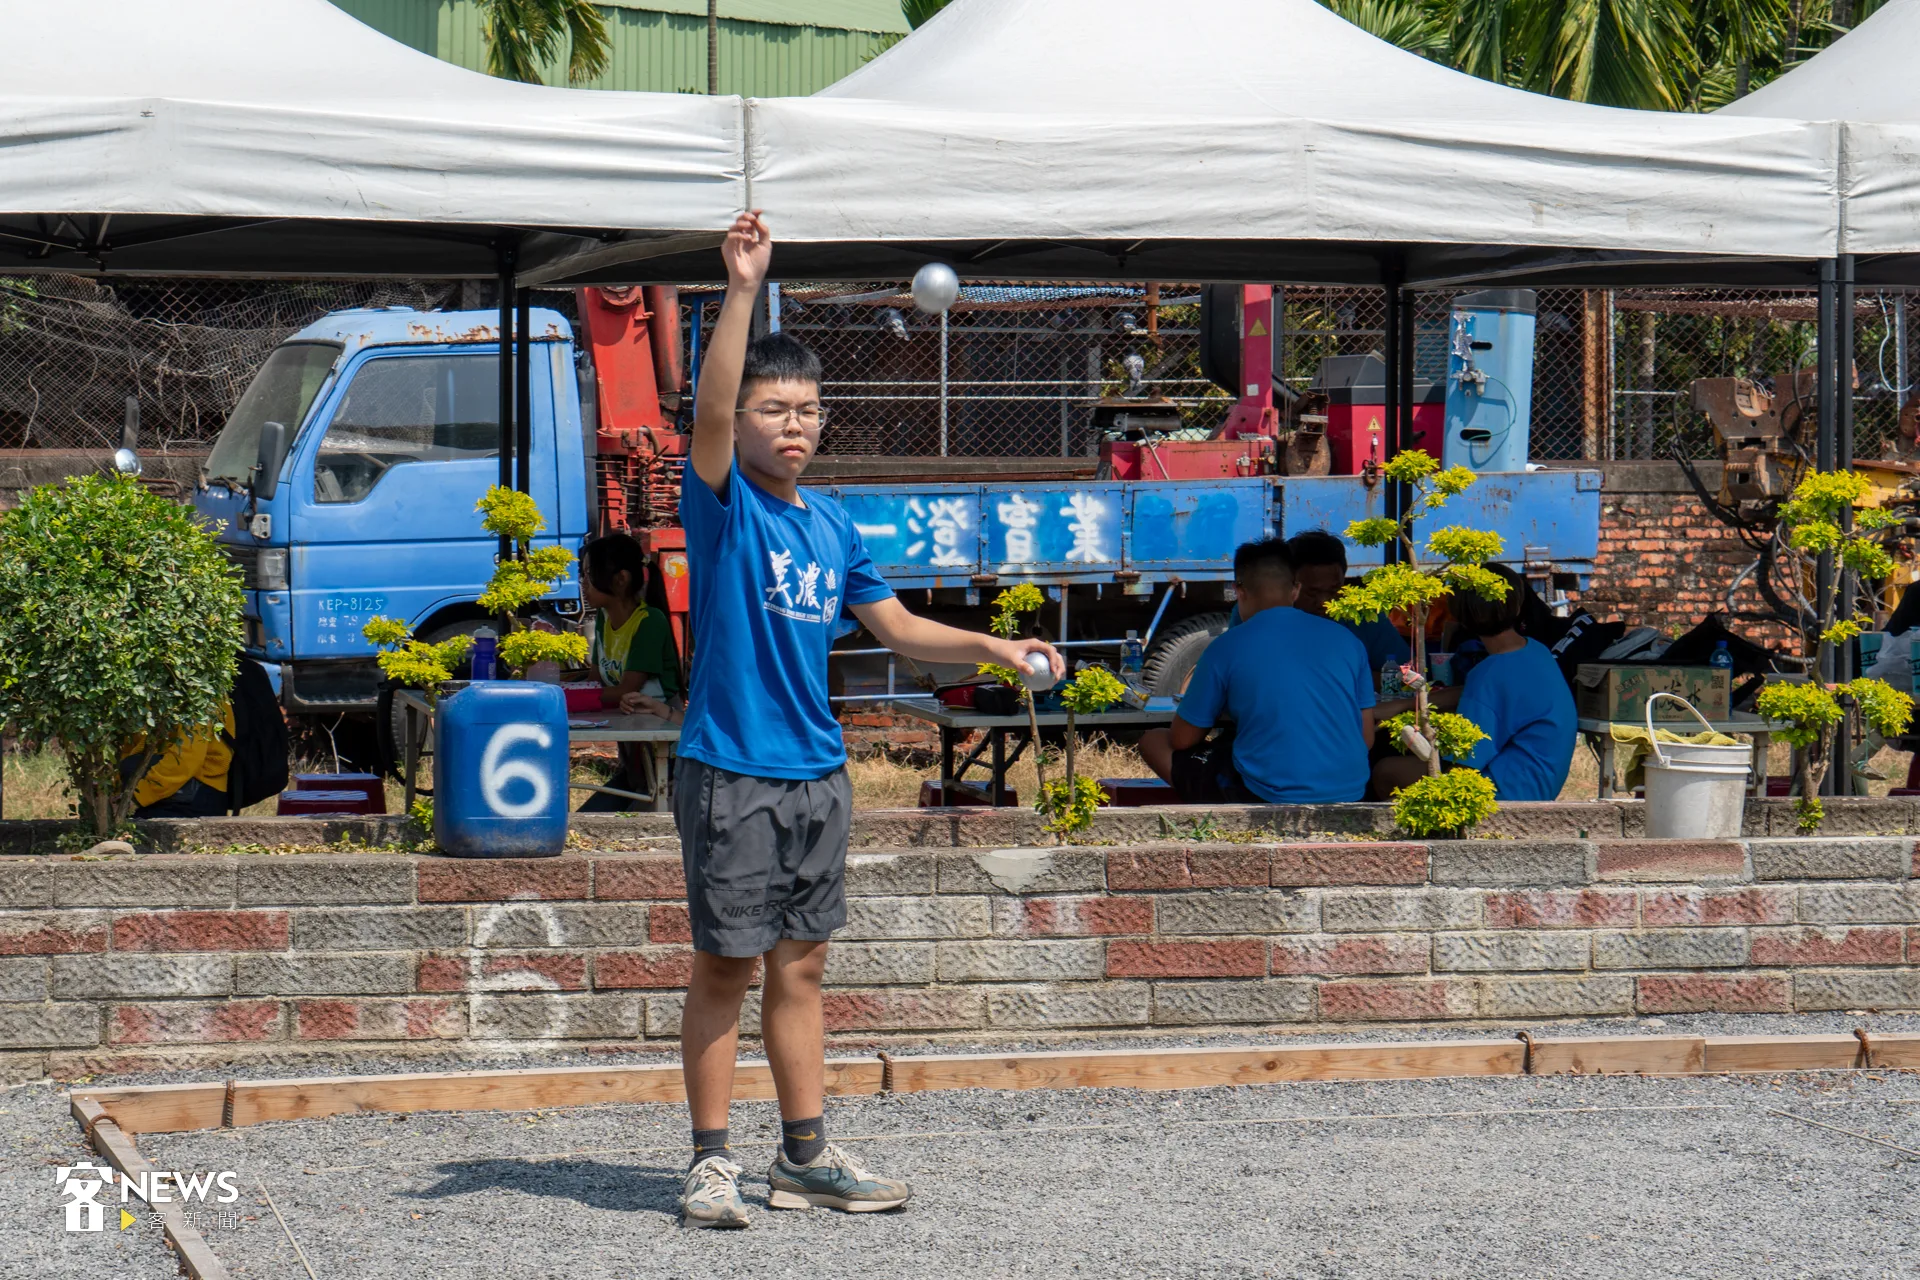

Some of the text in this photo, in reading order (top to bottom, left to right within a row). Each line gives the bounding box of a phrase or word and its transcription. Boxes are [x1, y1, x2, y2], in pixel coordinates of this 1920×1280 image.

[318, 597, 384, 611] KEP-8125
[480, 722, 552, 818] 6
[720, 904, 763, 918] NIKE
